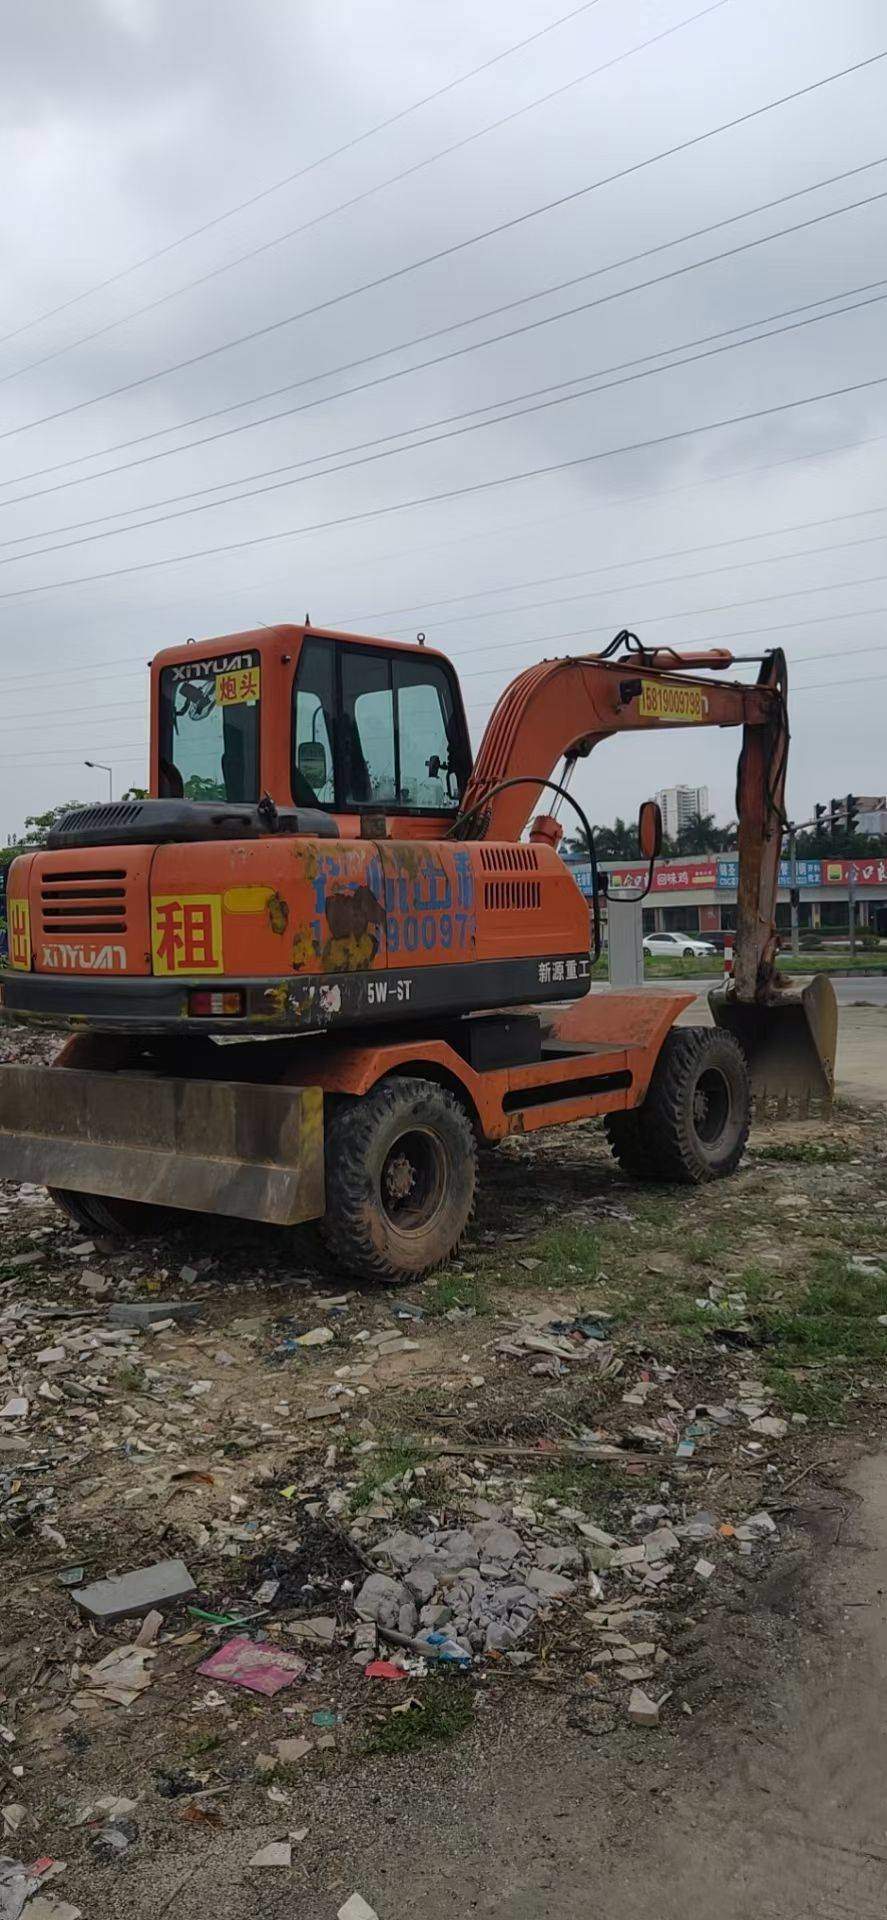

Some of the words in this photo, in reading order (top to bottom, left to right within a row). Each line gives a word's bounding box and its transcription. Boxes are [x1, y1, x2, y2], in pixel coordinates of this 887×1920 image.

[219, 672, 257, 702] 炮头
[12, 904, 28, 966] 出
[156, 901, 219, 971] 租
[538, 960, 591, 983] 新源重工
